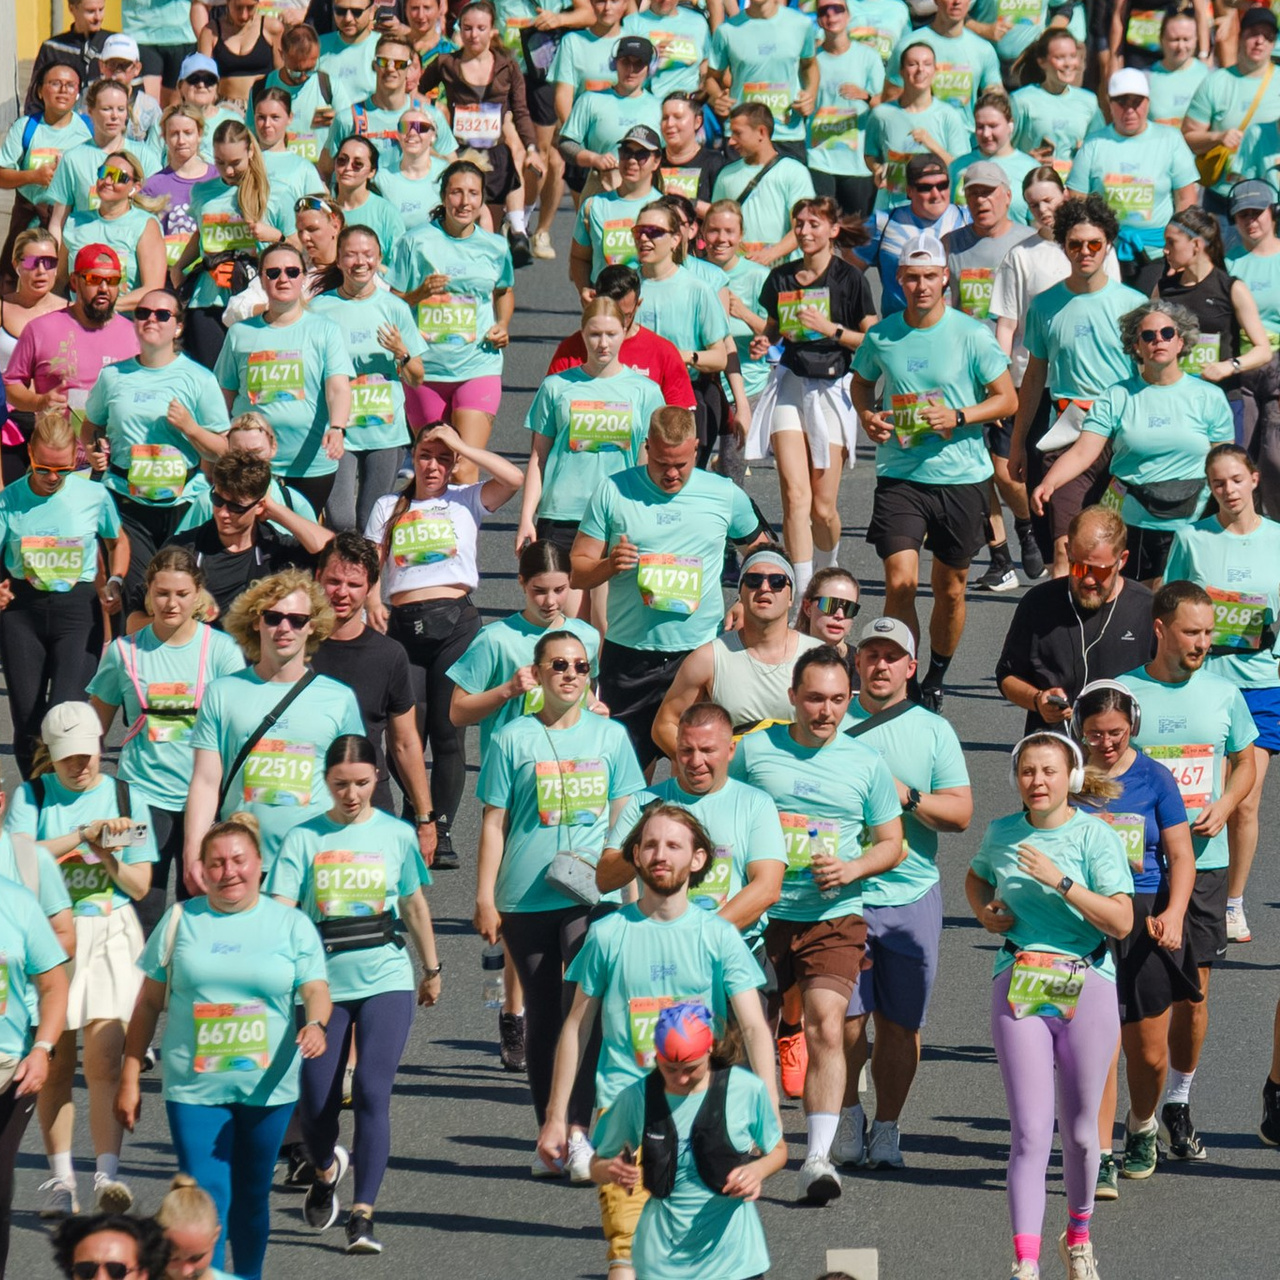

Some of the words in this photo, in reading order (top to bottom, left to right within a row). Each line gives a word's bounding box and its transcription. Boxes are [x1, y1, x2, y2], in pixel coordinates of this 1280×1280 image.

[455, 119, 500, 133] 53214
[1106, 187, 1153, 205] 73725
[421, 306, 475, 325] 70517
[249, 362, 300, 382] 71471
[573, 411, 630, 431] 79204
[132, 460, 184, 478] 77535
[395, 523, 452, 546] 81532
[642, 567, 699, 591] 71791
[1215, 601, 1264, 625] 9685
[246, 755, 313, 781] 72519
[540, 775, 606, 797] 75355
[317, 868, 384, 890] 81209
[1013, 970, 1081, 997] 77758
[197, 1021, 266, 1045] 66760
